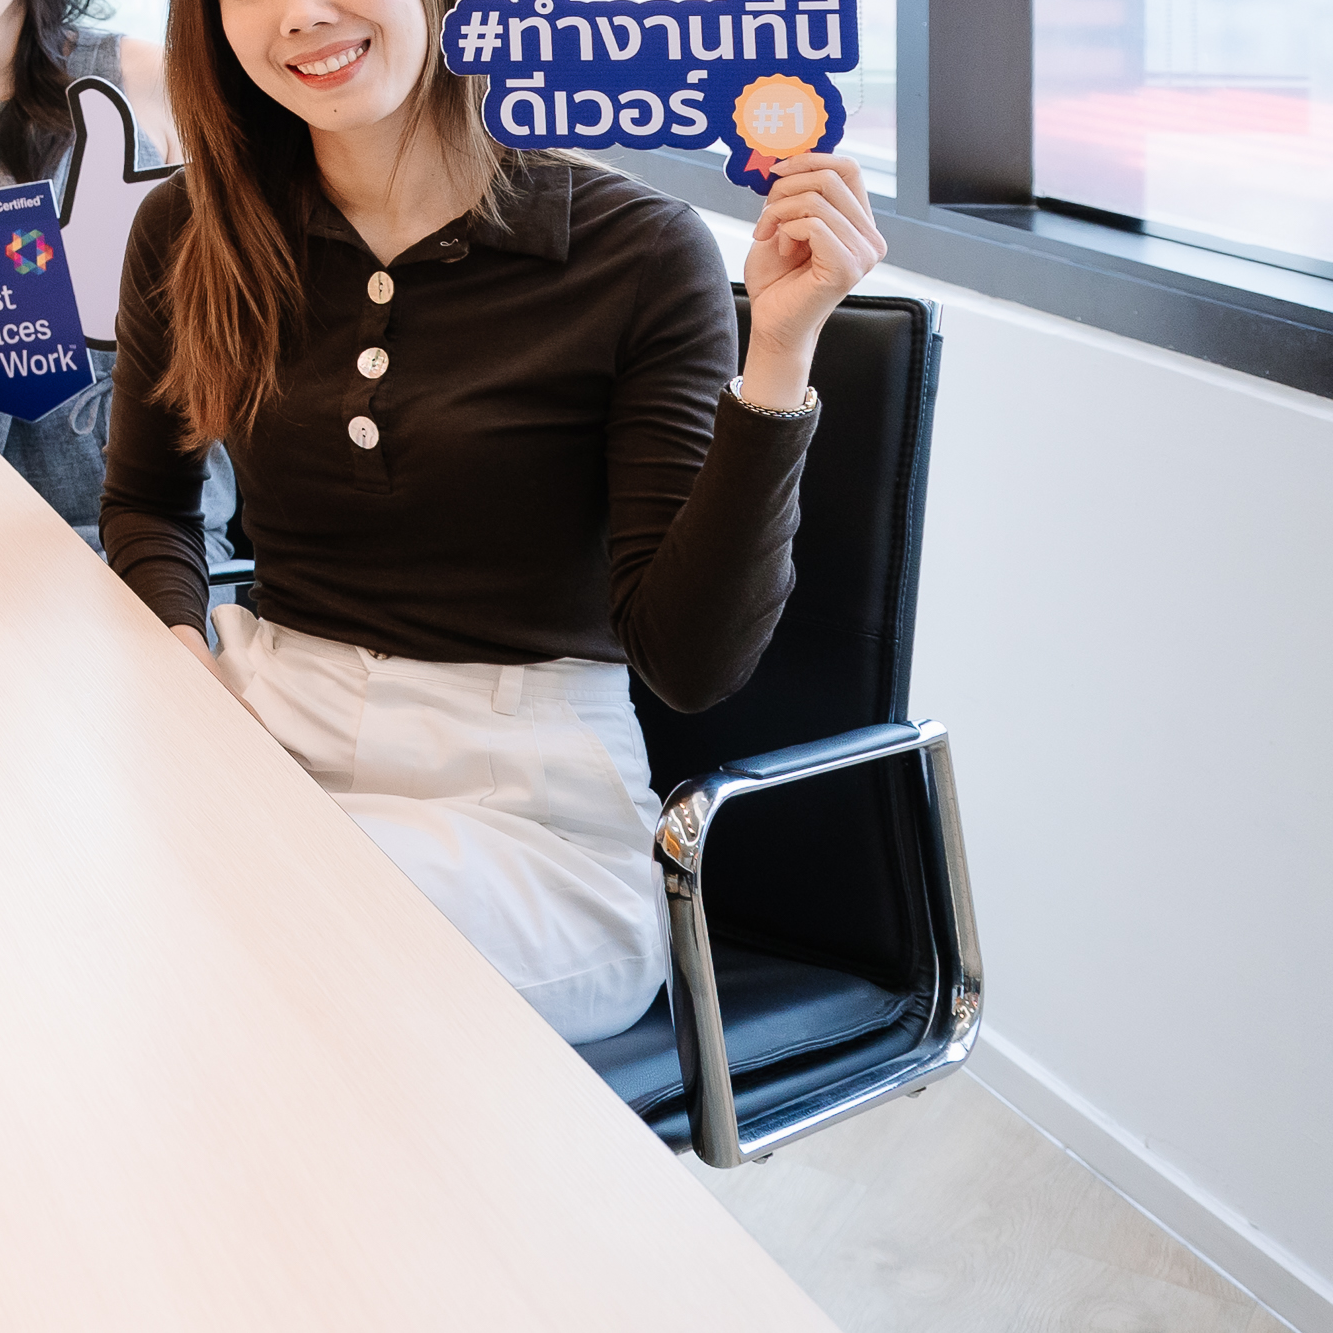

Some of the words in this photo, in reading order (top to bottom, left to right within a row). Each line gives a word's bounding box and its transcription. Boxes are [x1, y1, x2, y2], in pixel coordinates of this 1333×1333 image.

[499, 69, 709, 137] ดีเวอร์
[752, 102, 805, 135] #1
